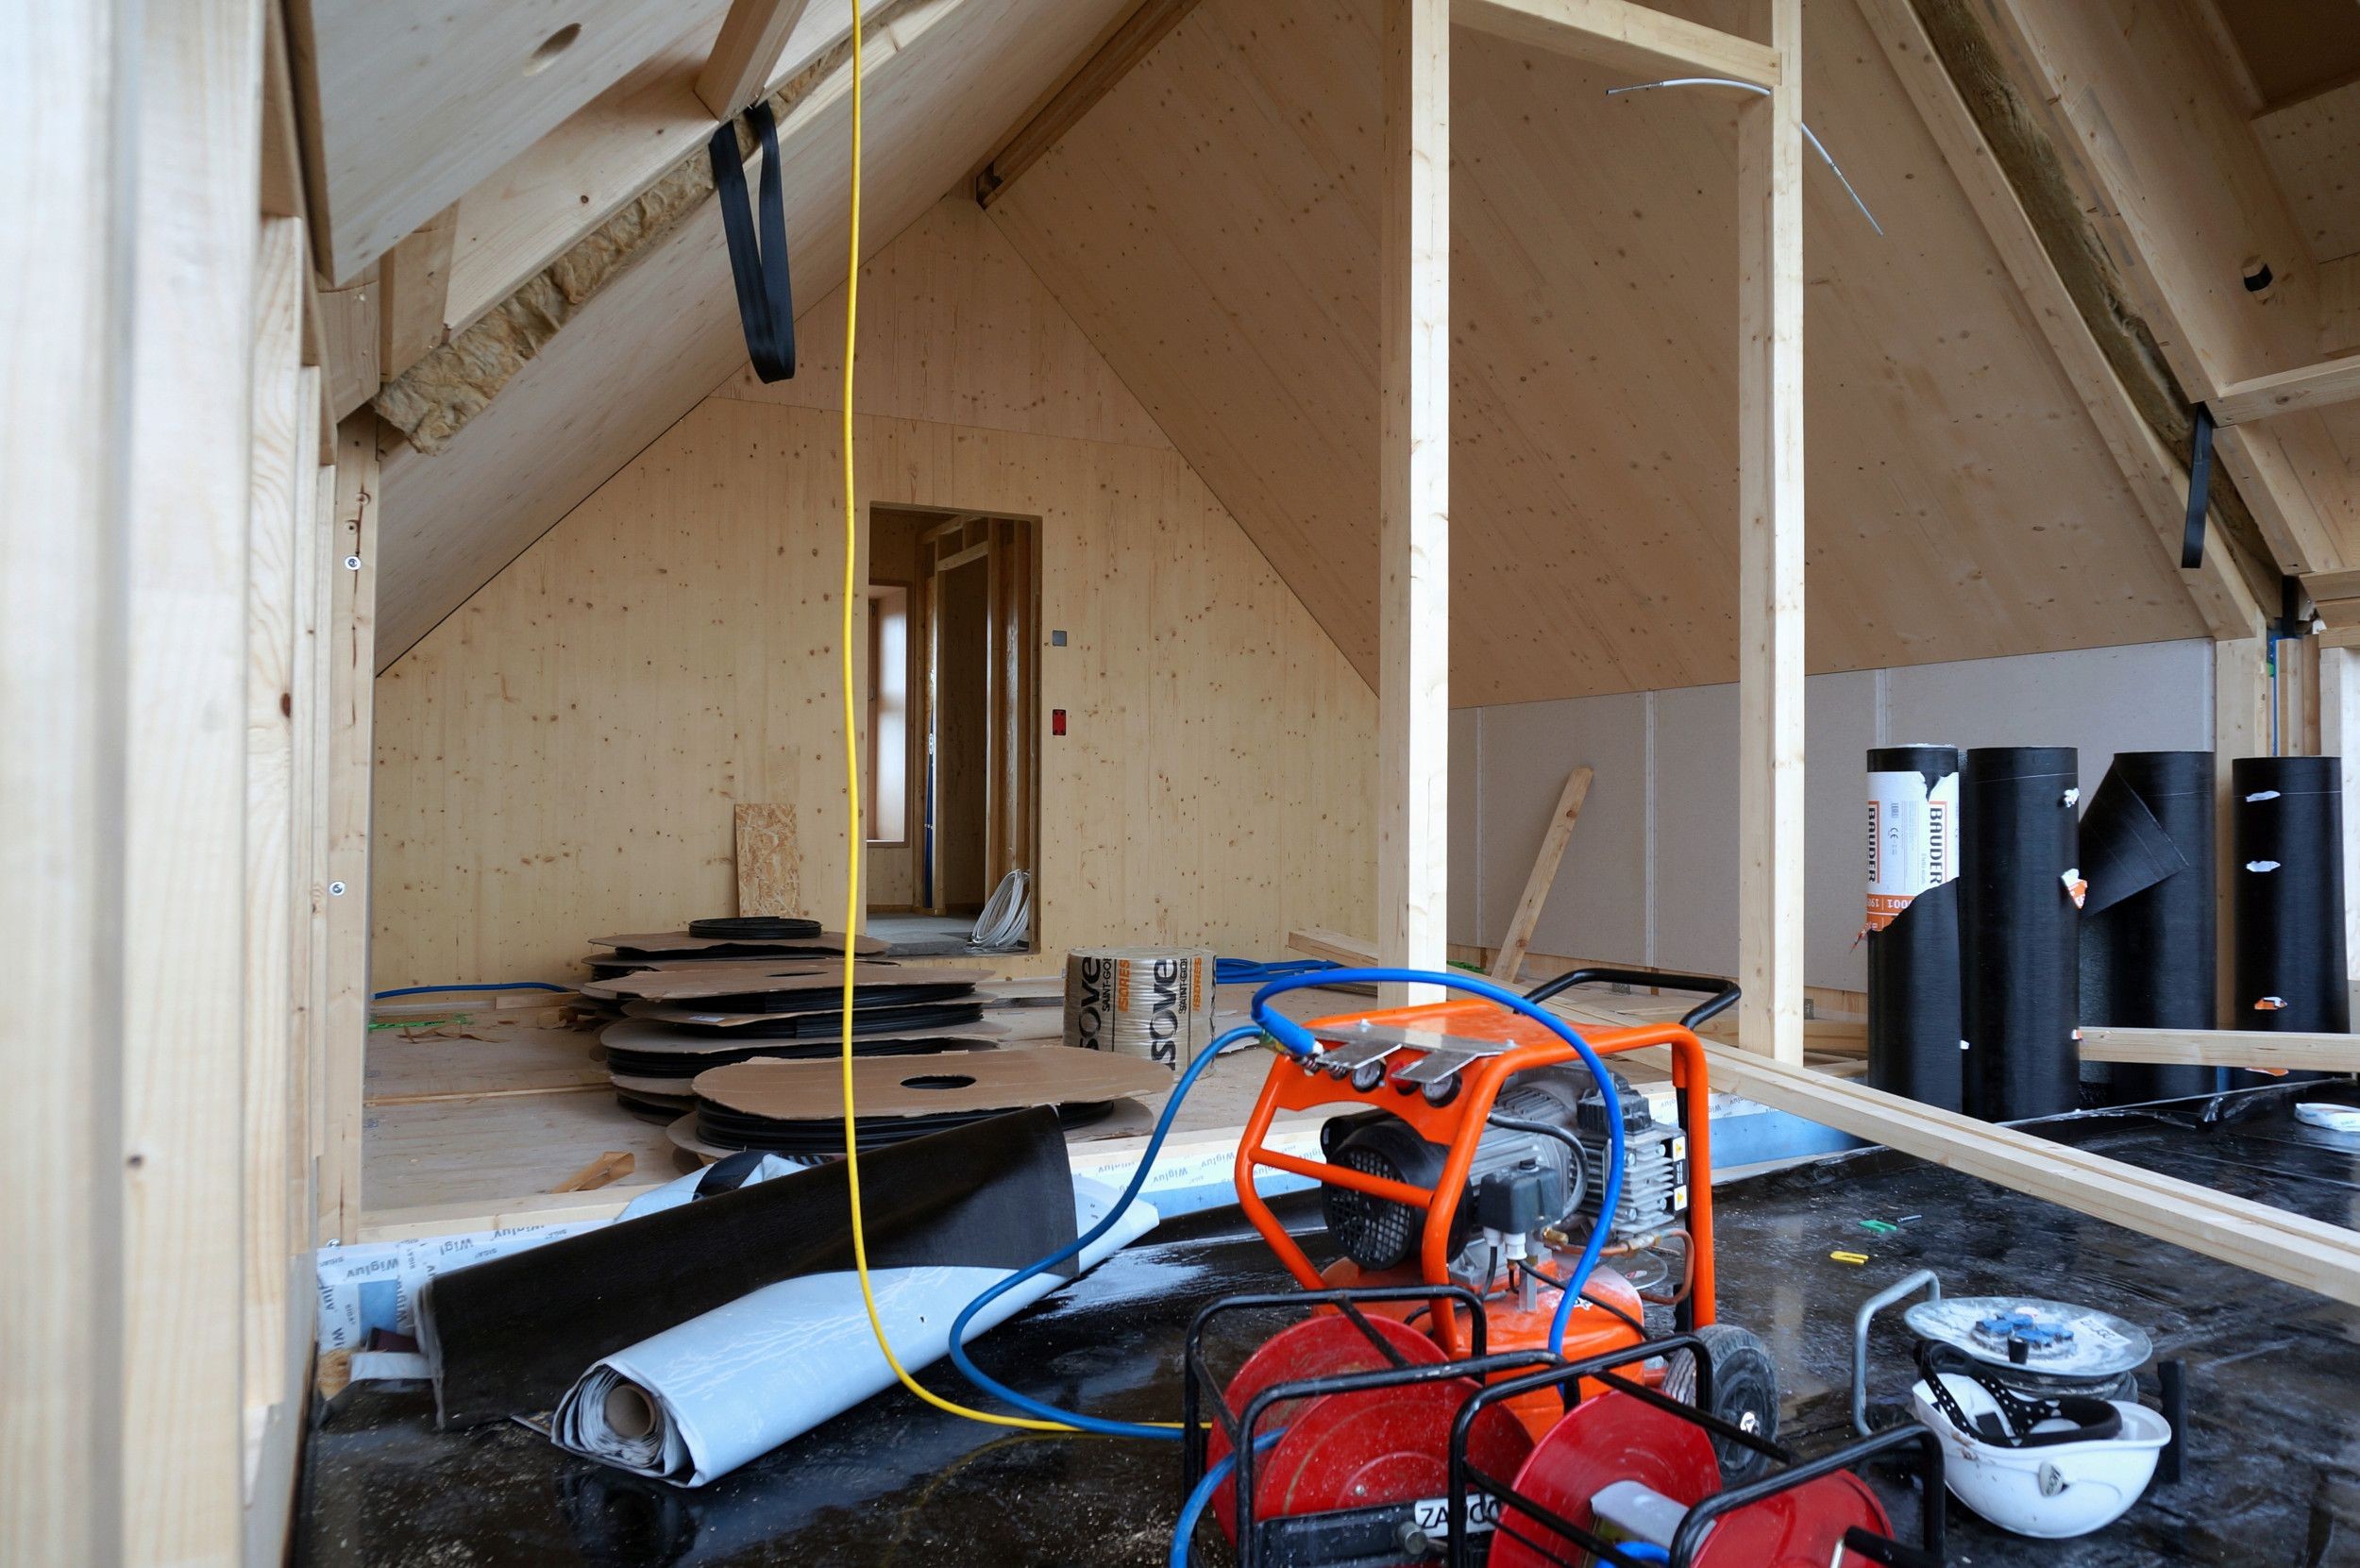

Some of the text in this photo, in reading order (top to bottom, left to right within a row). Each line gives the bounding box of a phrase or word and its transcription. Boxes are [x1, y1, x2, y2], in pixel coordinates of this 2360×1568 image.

[1868, 808, 1877, 883] BAUDER
[1930, 808, 1943, 885] BAUDER
[1153, 1167, 1188, 1183] Wigluv
[1201, 1152, 1236, 1168] Wigluv
